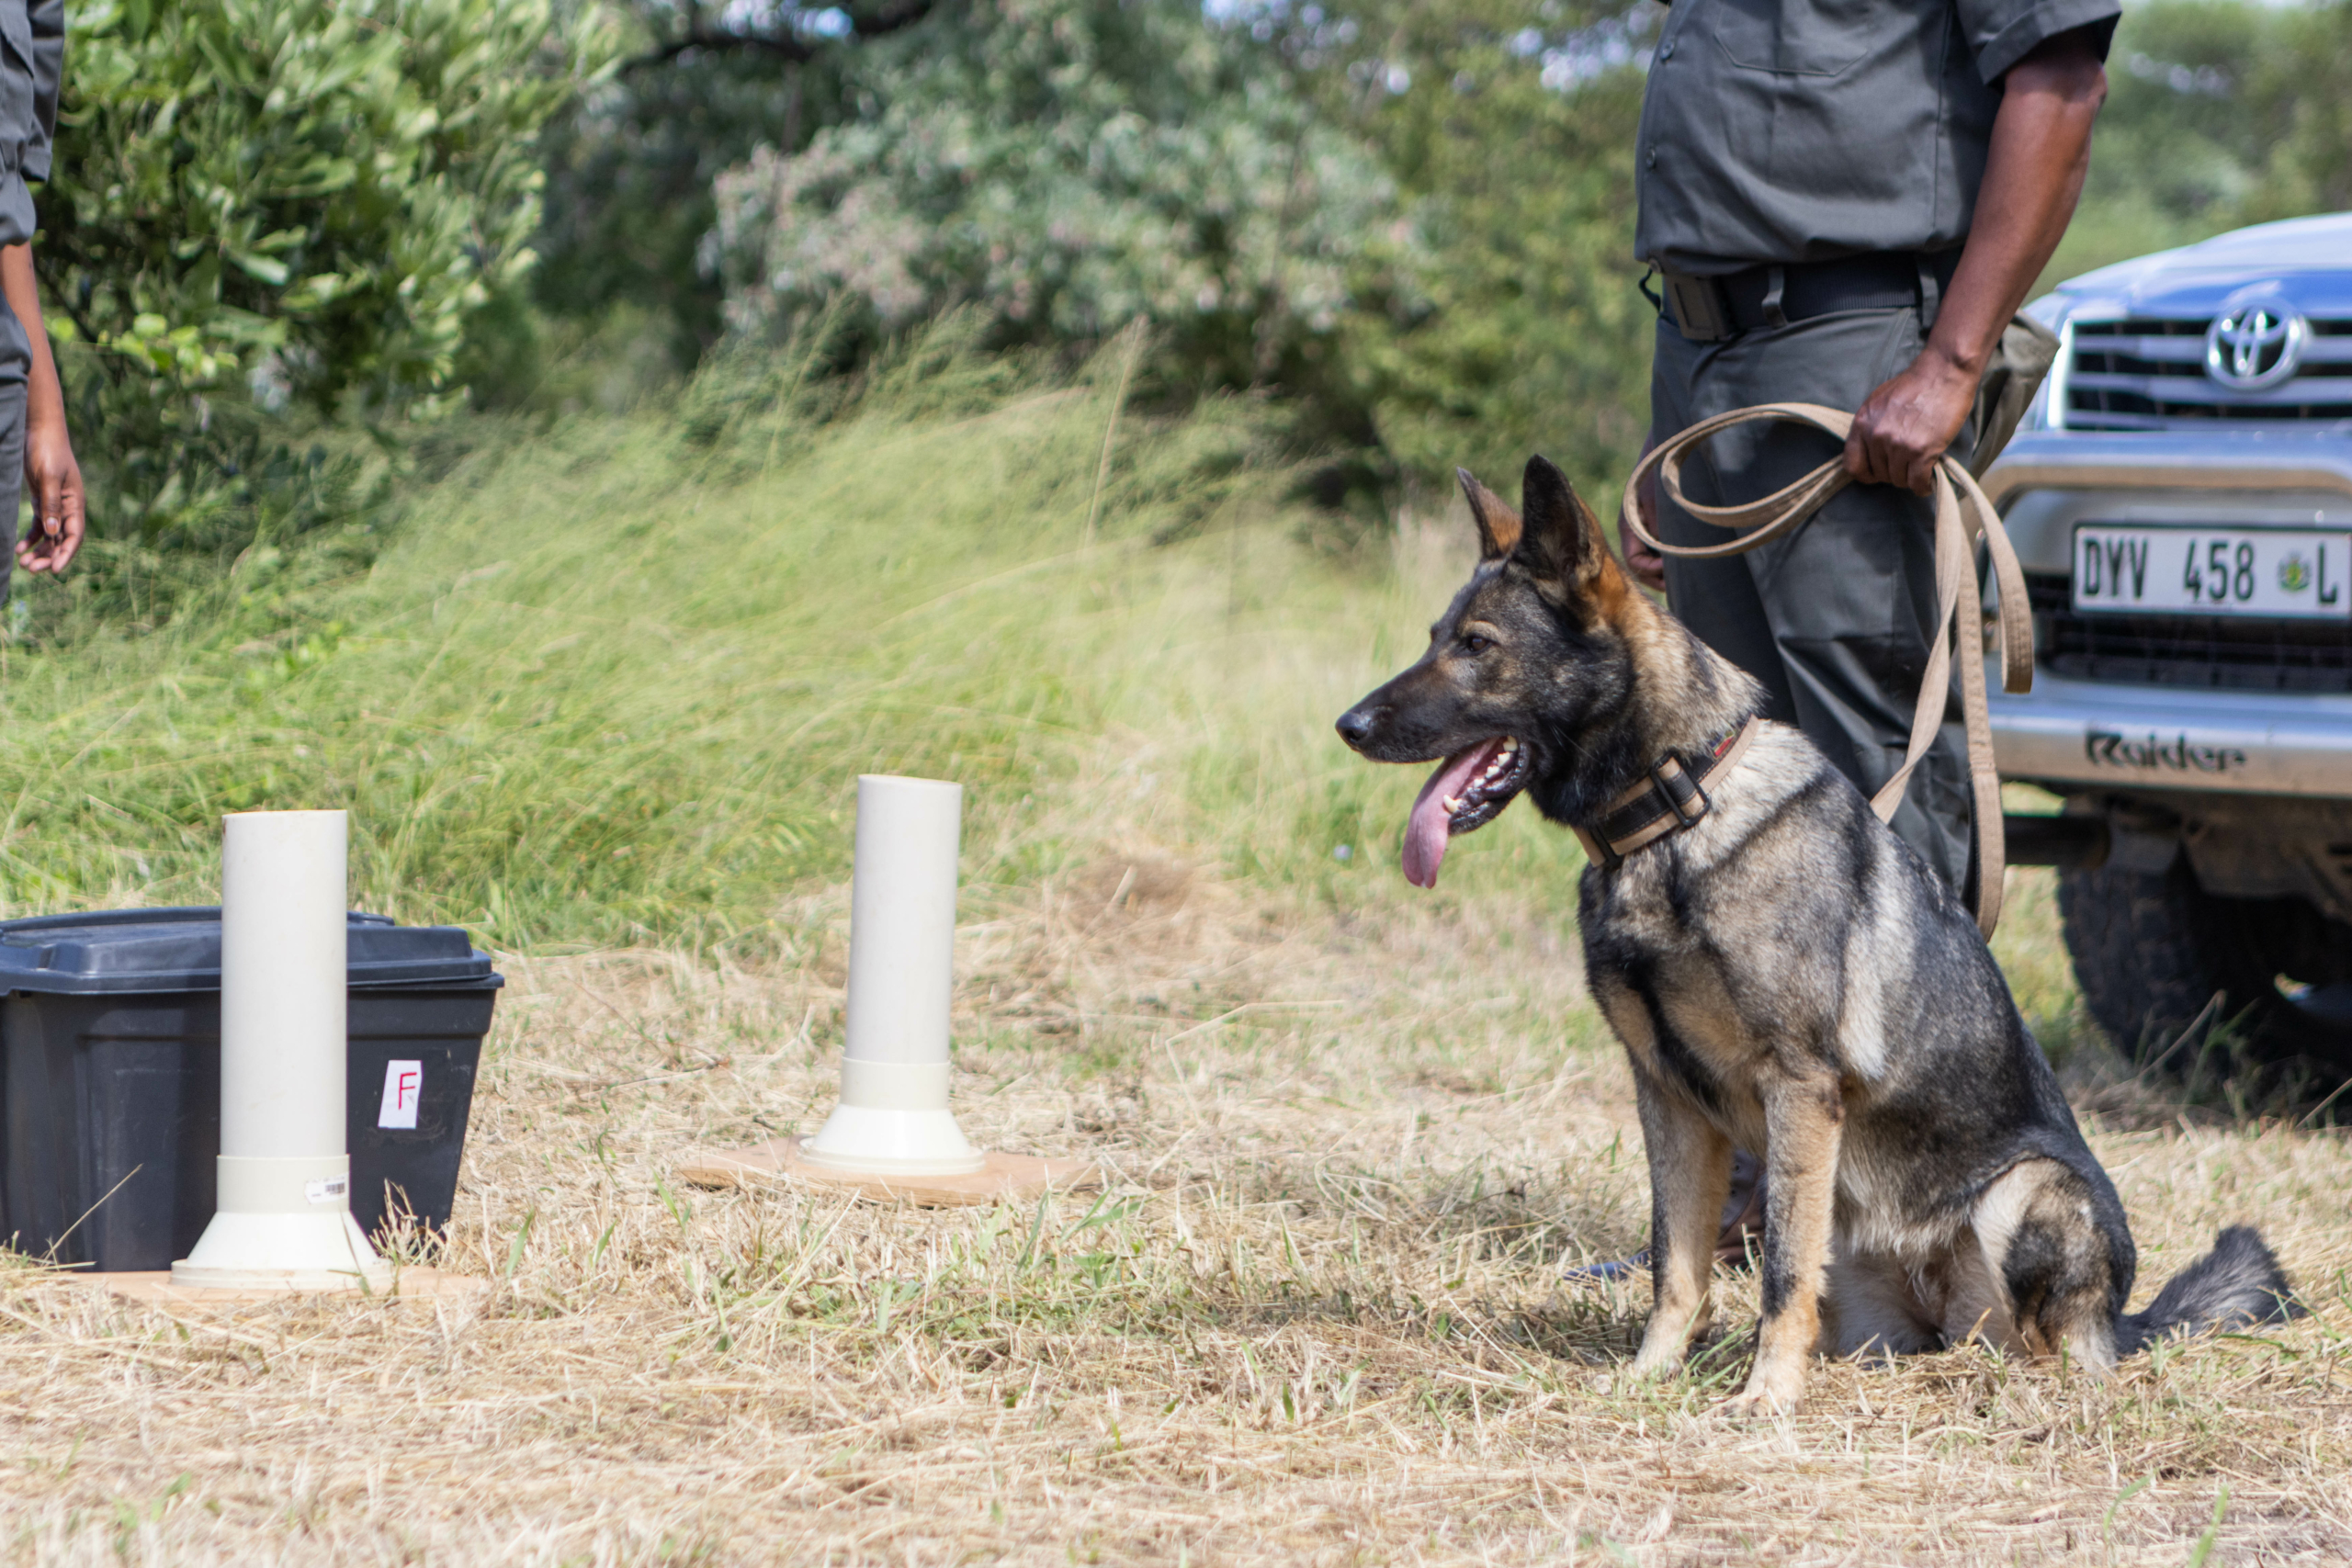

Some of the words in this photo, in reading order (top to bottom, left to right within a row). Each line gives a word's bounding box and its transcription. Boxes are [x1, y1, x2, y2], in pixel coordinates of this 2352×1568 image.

[2084, 537, 2147, 599] DYV
[2184, 538, 2254, 602] 458
[2317, 542, 2337, 604] L
[2085, 730, 2246, 773] Raider
[399, 1072, 416, 1110] F
